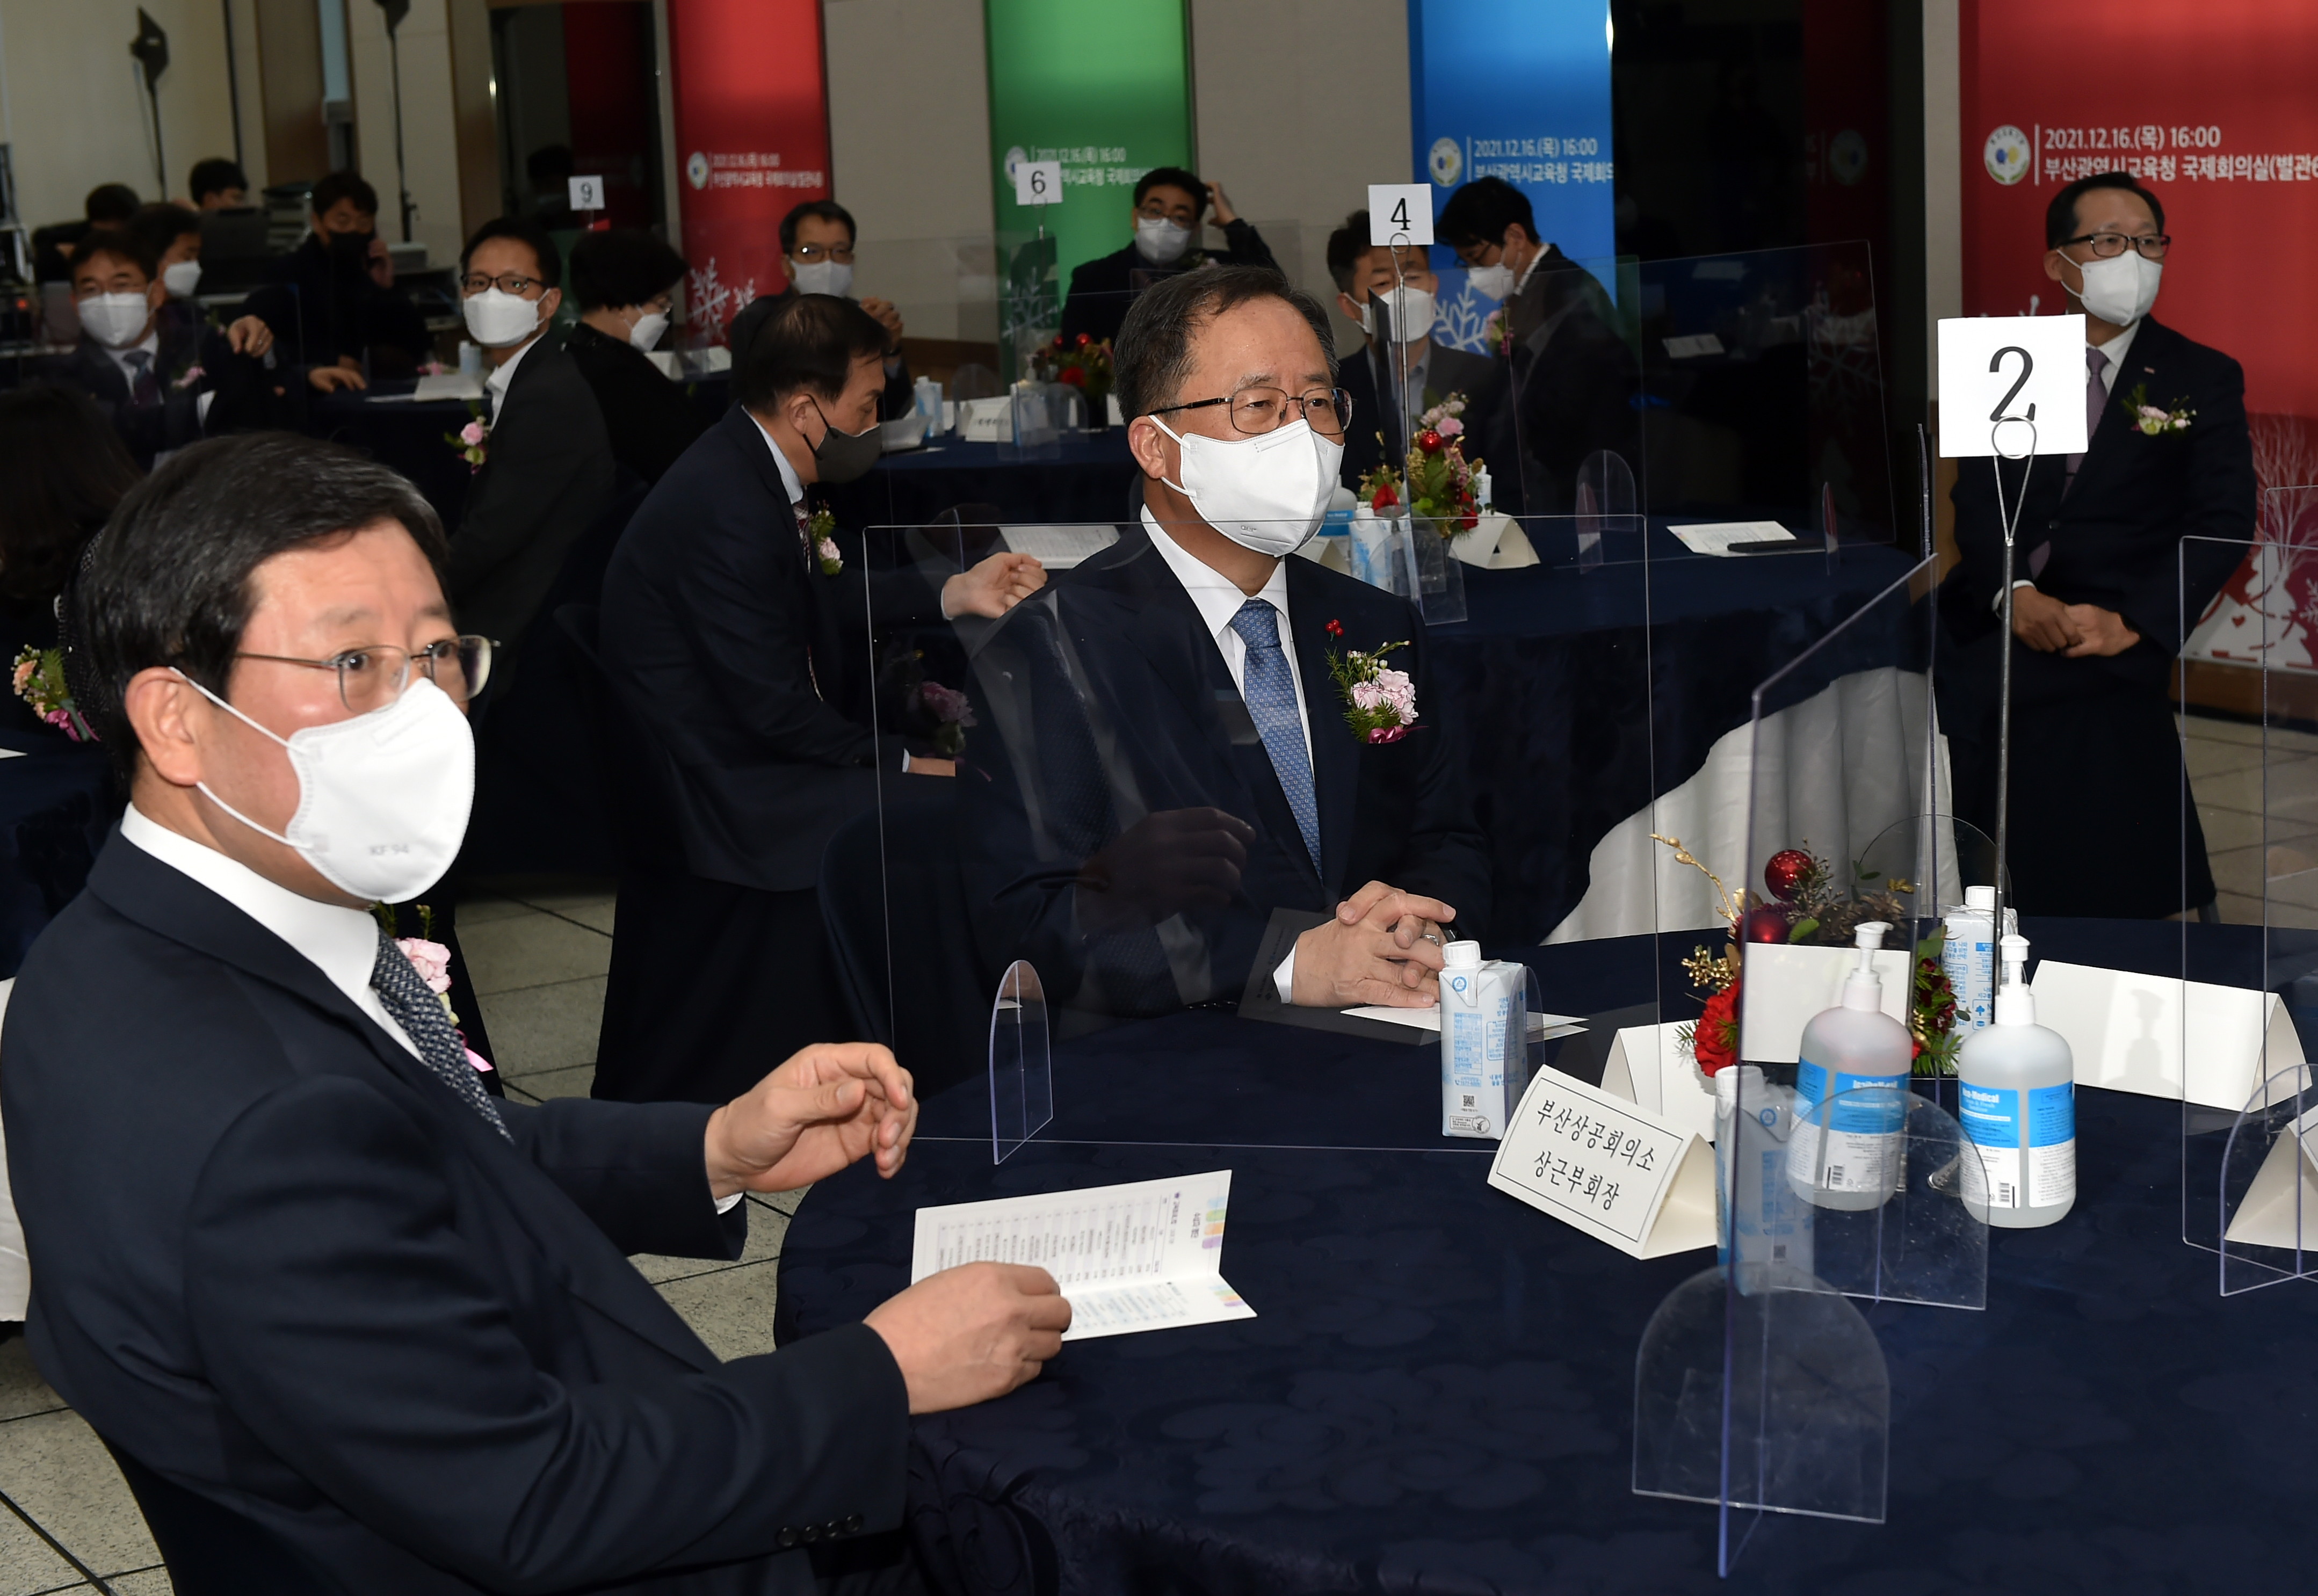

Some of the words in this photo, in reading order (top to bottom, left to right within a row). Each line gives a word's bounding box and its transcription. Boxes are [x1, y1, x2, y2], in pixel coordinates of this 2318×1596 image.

[1562, 136, 1598, 156] 16:00
[2045, 125, 2165, 151] 2021.12.16.(목)
[2170, 125, 2221, 148] 16:00
[581, 182, 593, 203] 9
[1031, 170, 1046, 194] 6
[1390, 198, 1411, 230] 4
[1989, 346, 2036, 422] 2
[1537, 1099, 1654, 1171] 부산상공회의소
[1534, 1150, 1619, 1210] 상근부회장
